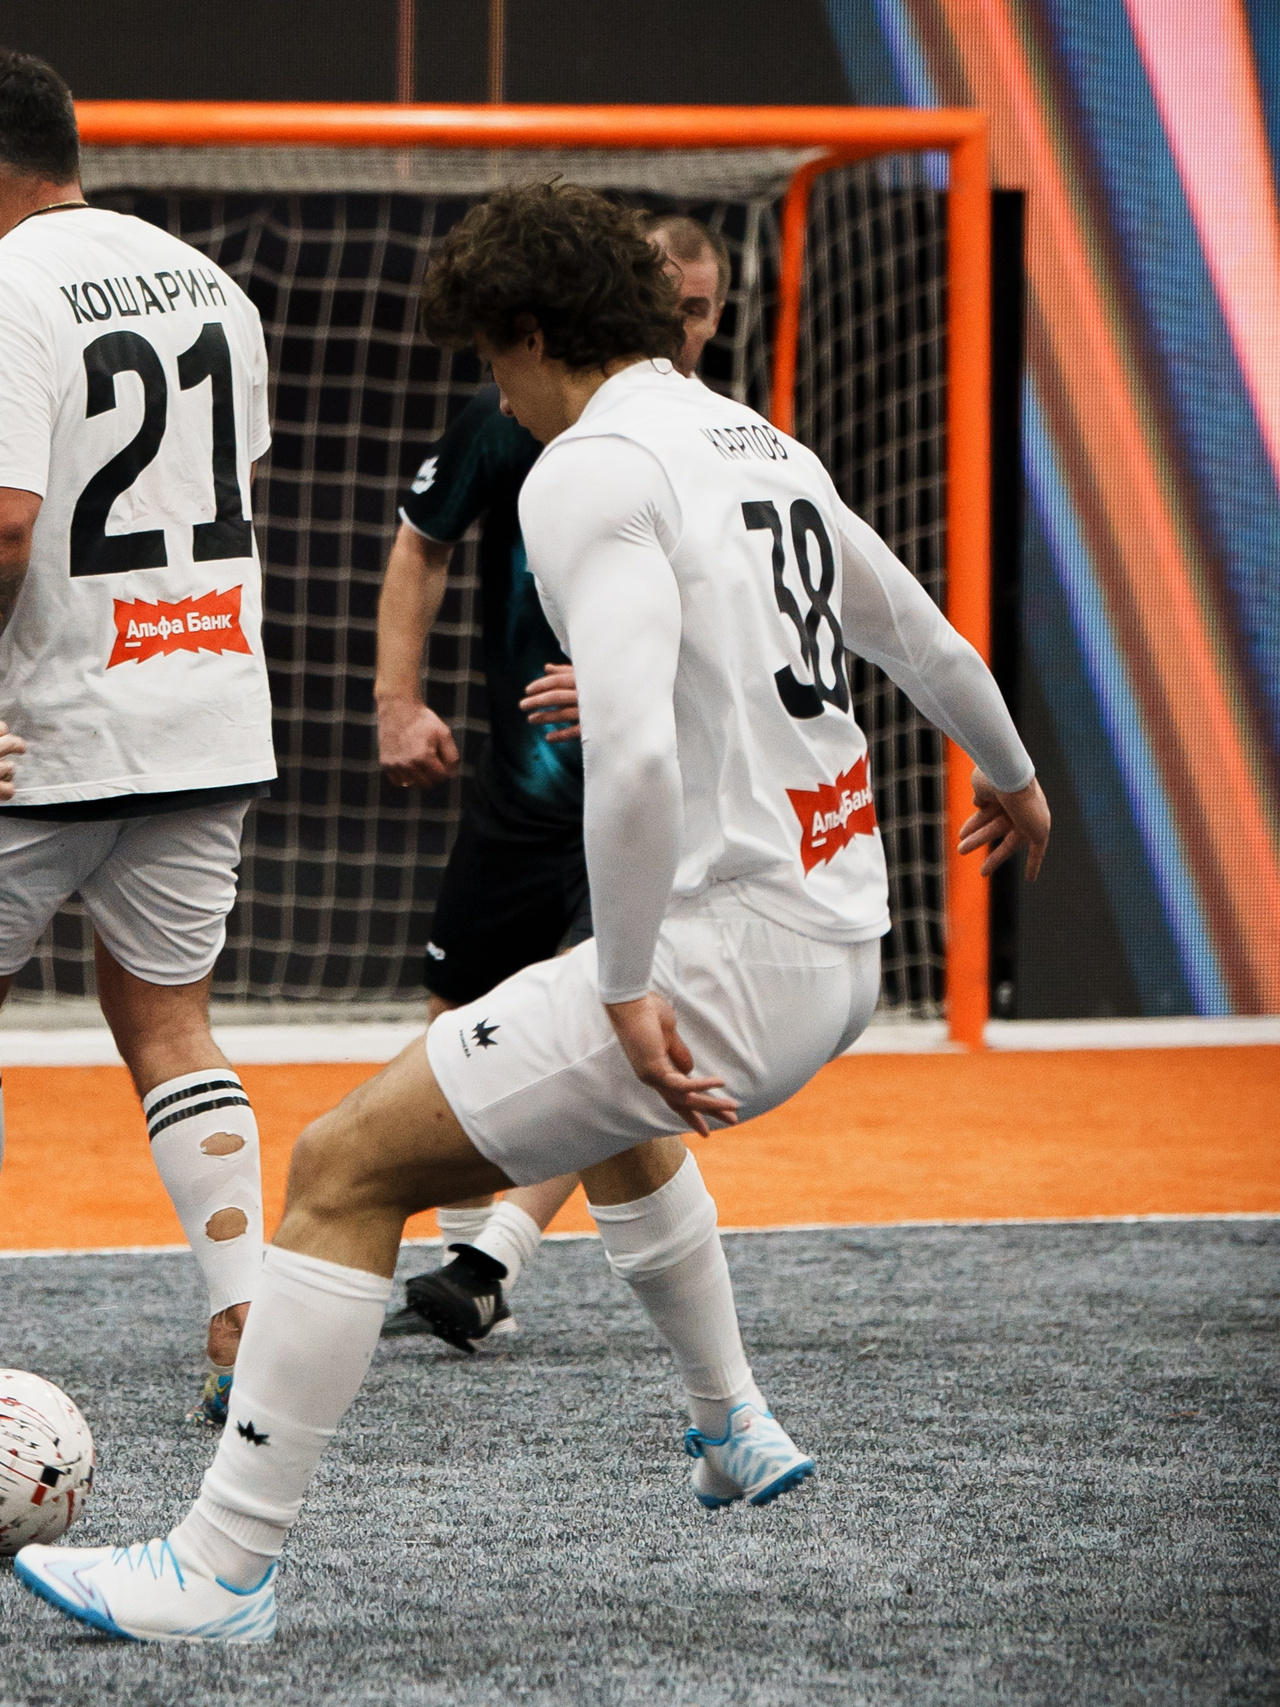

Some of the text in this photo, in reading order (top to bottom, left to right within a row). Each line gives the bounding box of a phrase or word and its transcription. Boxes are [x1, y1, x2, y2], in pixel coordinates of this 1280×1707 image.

[59, 268, 227, 324] КОШАРИН
[69, 321, 254, 578] 21
[699, 424, 788, 461] КАРПОВ
[125, 612, 233, 641] Альфа Банк
[741, 498, 850, 720] 38
[841, 788, 873, 816] Бан
